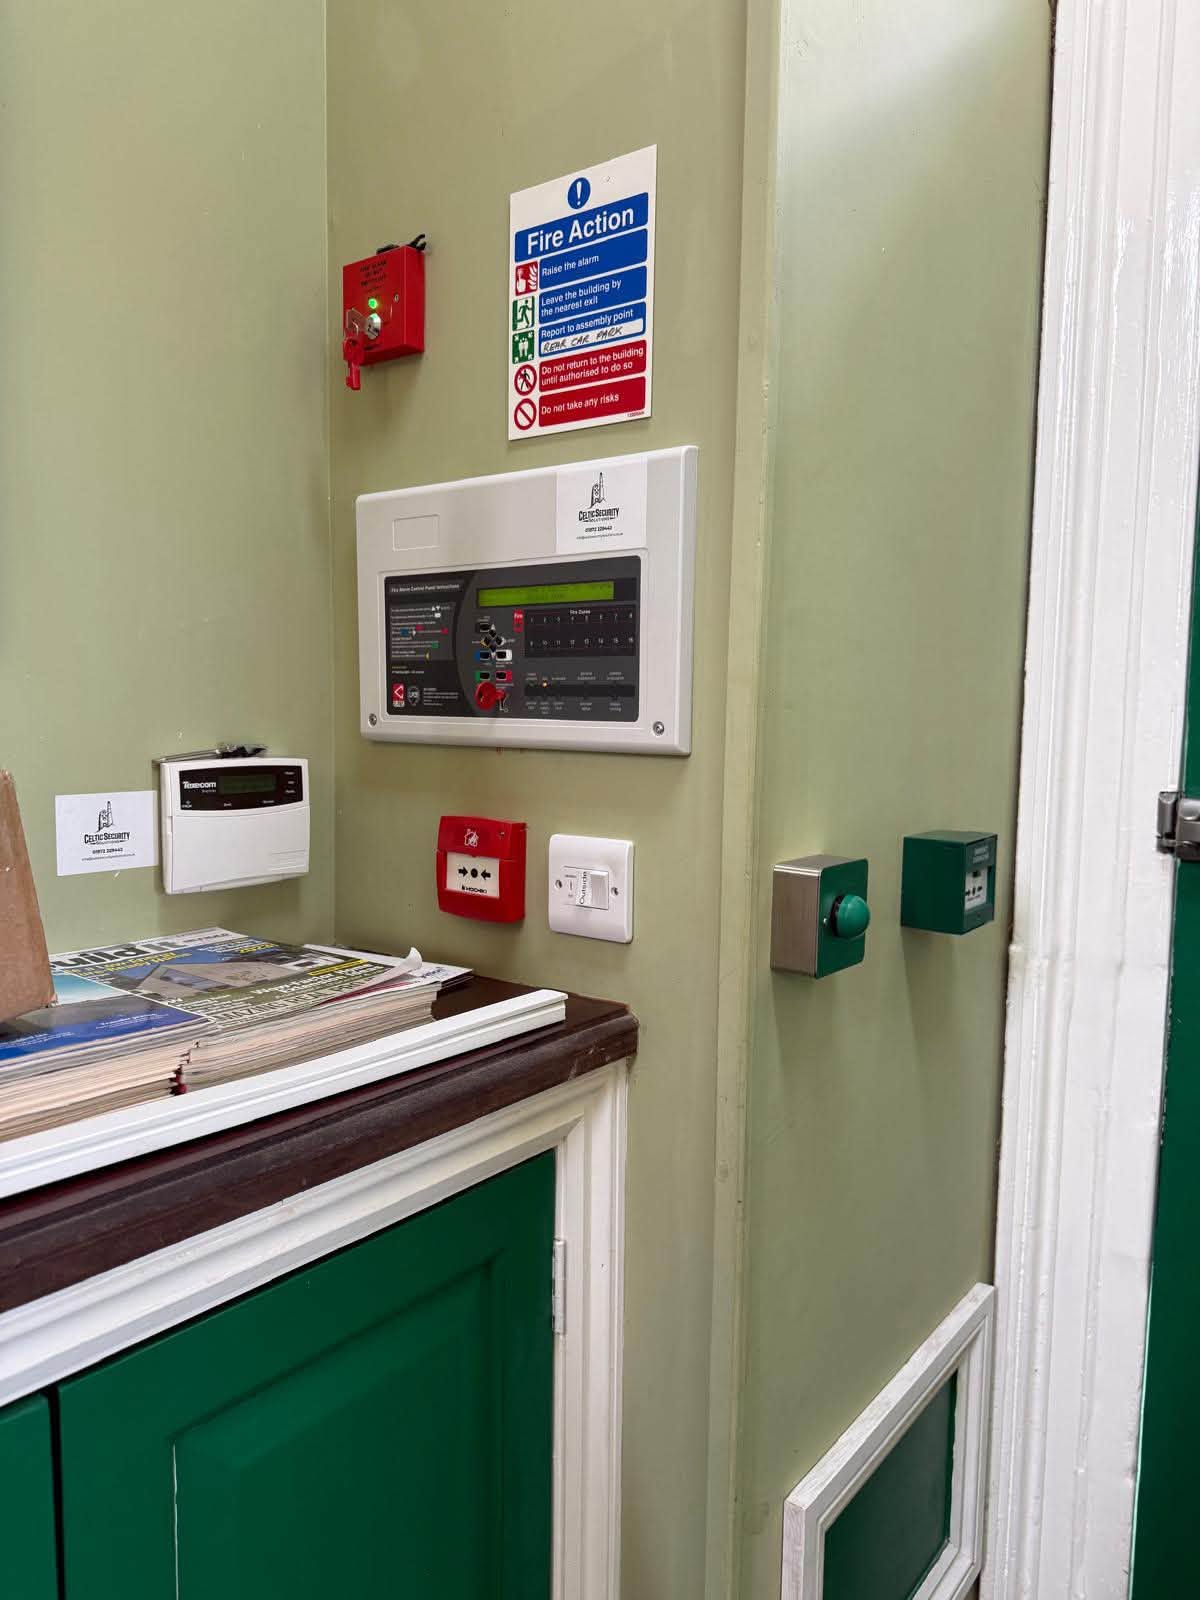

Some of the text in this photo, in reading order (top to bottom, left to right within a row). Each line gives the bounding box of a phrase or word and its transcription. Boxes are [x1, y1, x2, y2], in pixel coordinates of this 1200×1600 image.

[527, 208, 634, 255] Fire Action
[541, 255, 600, 277] Raise the alarm
[541, 279, 622, 307] Leave the building by
[541, 296, 598, 317] the nearest exit
[541, 308, 634, 340] Report to assembly point
[543, 325, 623, 353] REAR CAR PARK
[541, 347, 644, 375] Do not return to the building
[541, 361, 633, 386] until authorised to do so
[541, 392, 619, 415] Do not take any risks
[84, 832, 130, 844] CELTIC SECURITY
[579, 871, 588, 904] Outside
[50, 946, 147, 968] uild
